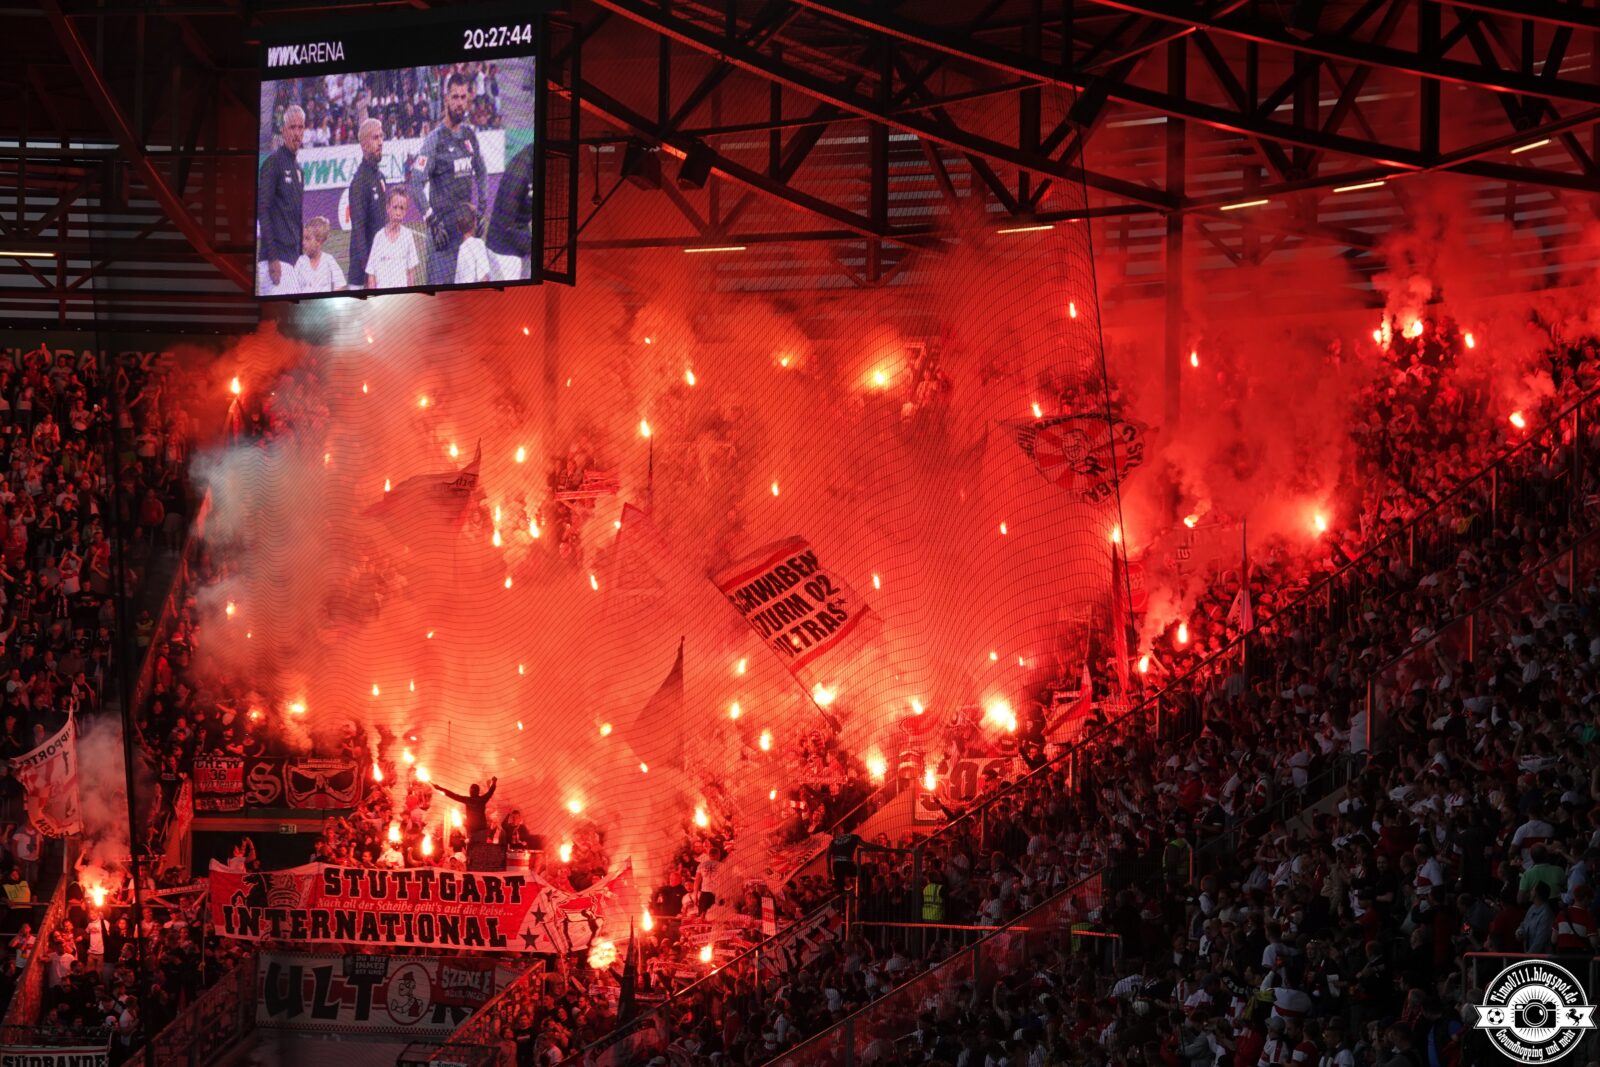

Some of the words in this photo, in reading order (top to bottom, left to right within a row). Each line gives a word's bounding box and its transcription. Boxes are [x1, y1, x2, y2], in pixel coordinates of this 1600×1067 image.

[463, 23, 532, 50] 20:27:44
[804, 574, 841, 604] 02
[209, 769, 227, 781] 36
[324, 867, 526, 904] STUTTGART
[317, 898, 341, 908] Nach
[342, 900, 357, 909] all
[358, 900, 375, 911] der
[376, 900, 413, 912] Scheiße
[414, 902, 442, 915] geht's
[444, 904, 461, 915] auf
[462, 905, 478, 915] die
[223, 905, 507, 947] INTERNATIONAL
[441, 965, 481, 990] SZENE
